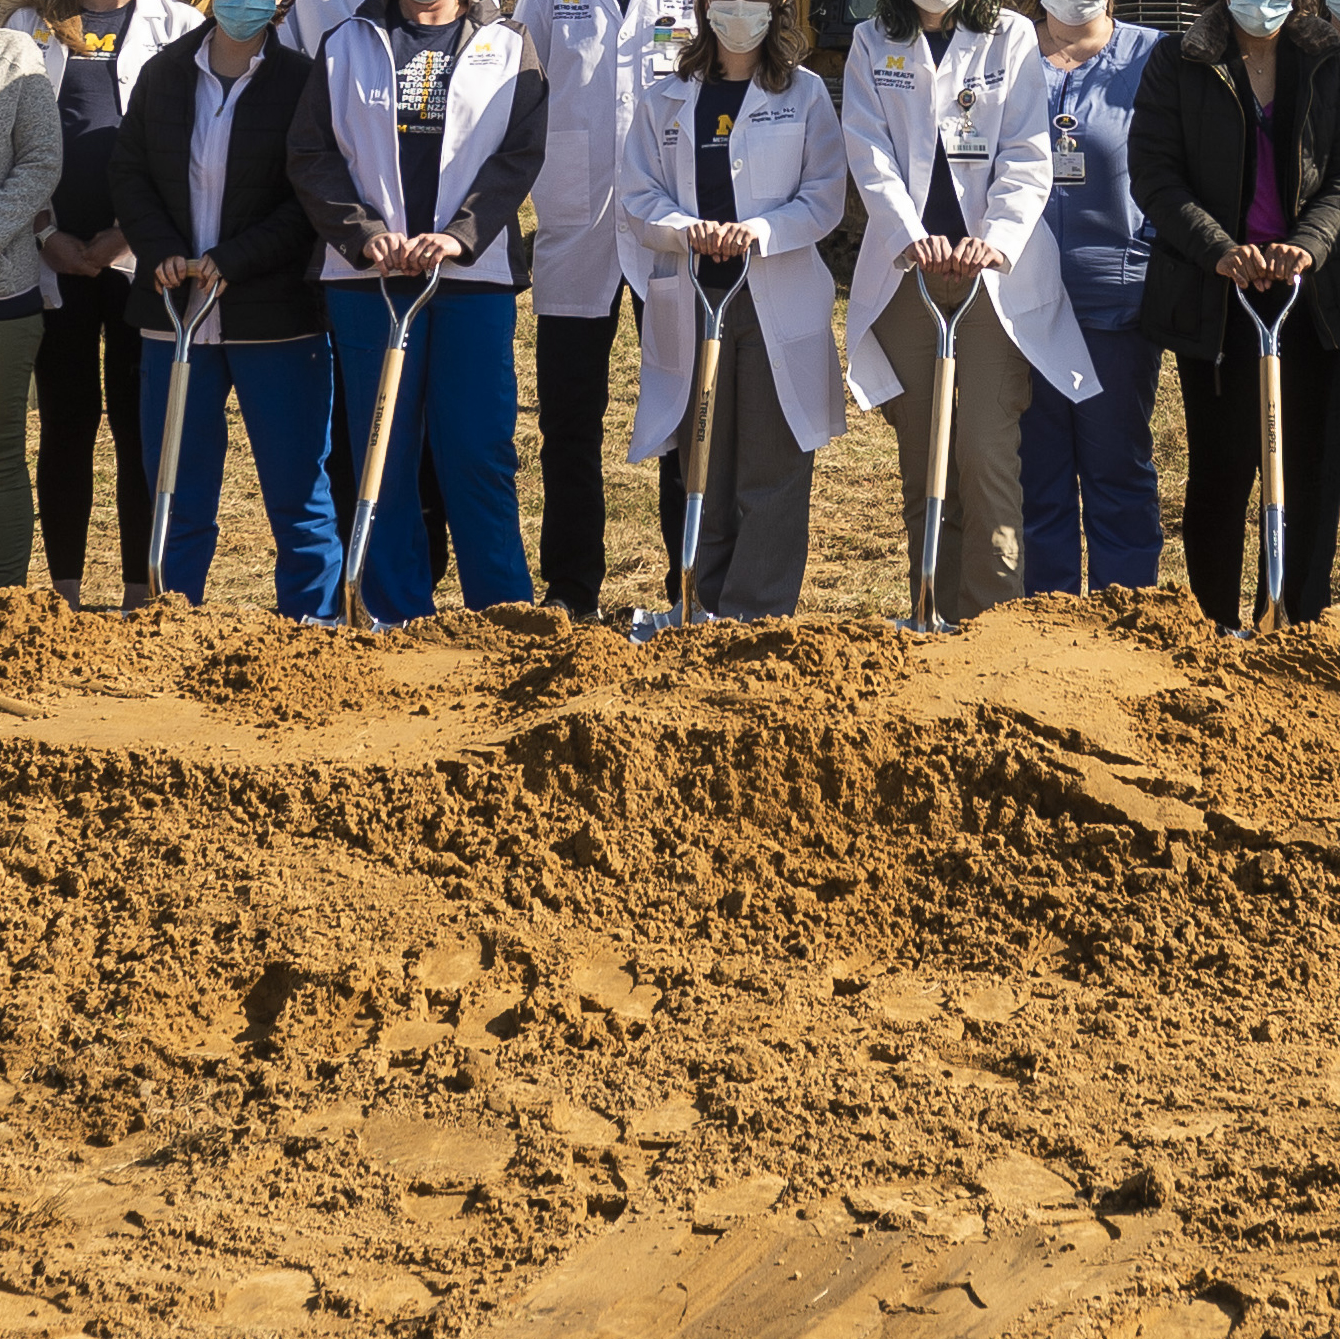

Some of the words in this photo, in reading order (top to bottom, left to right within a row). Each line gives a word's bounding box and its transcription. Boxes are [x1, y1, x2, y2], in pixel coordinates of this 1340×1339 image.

[84, 33, 117, 52] M
[886, 56, 906, 70] M
[397, 102, 446, 111] NFLUENZA
[370, 406, 385, 447] TRUPER
[697, 401, 709, 442] TRUPER
